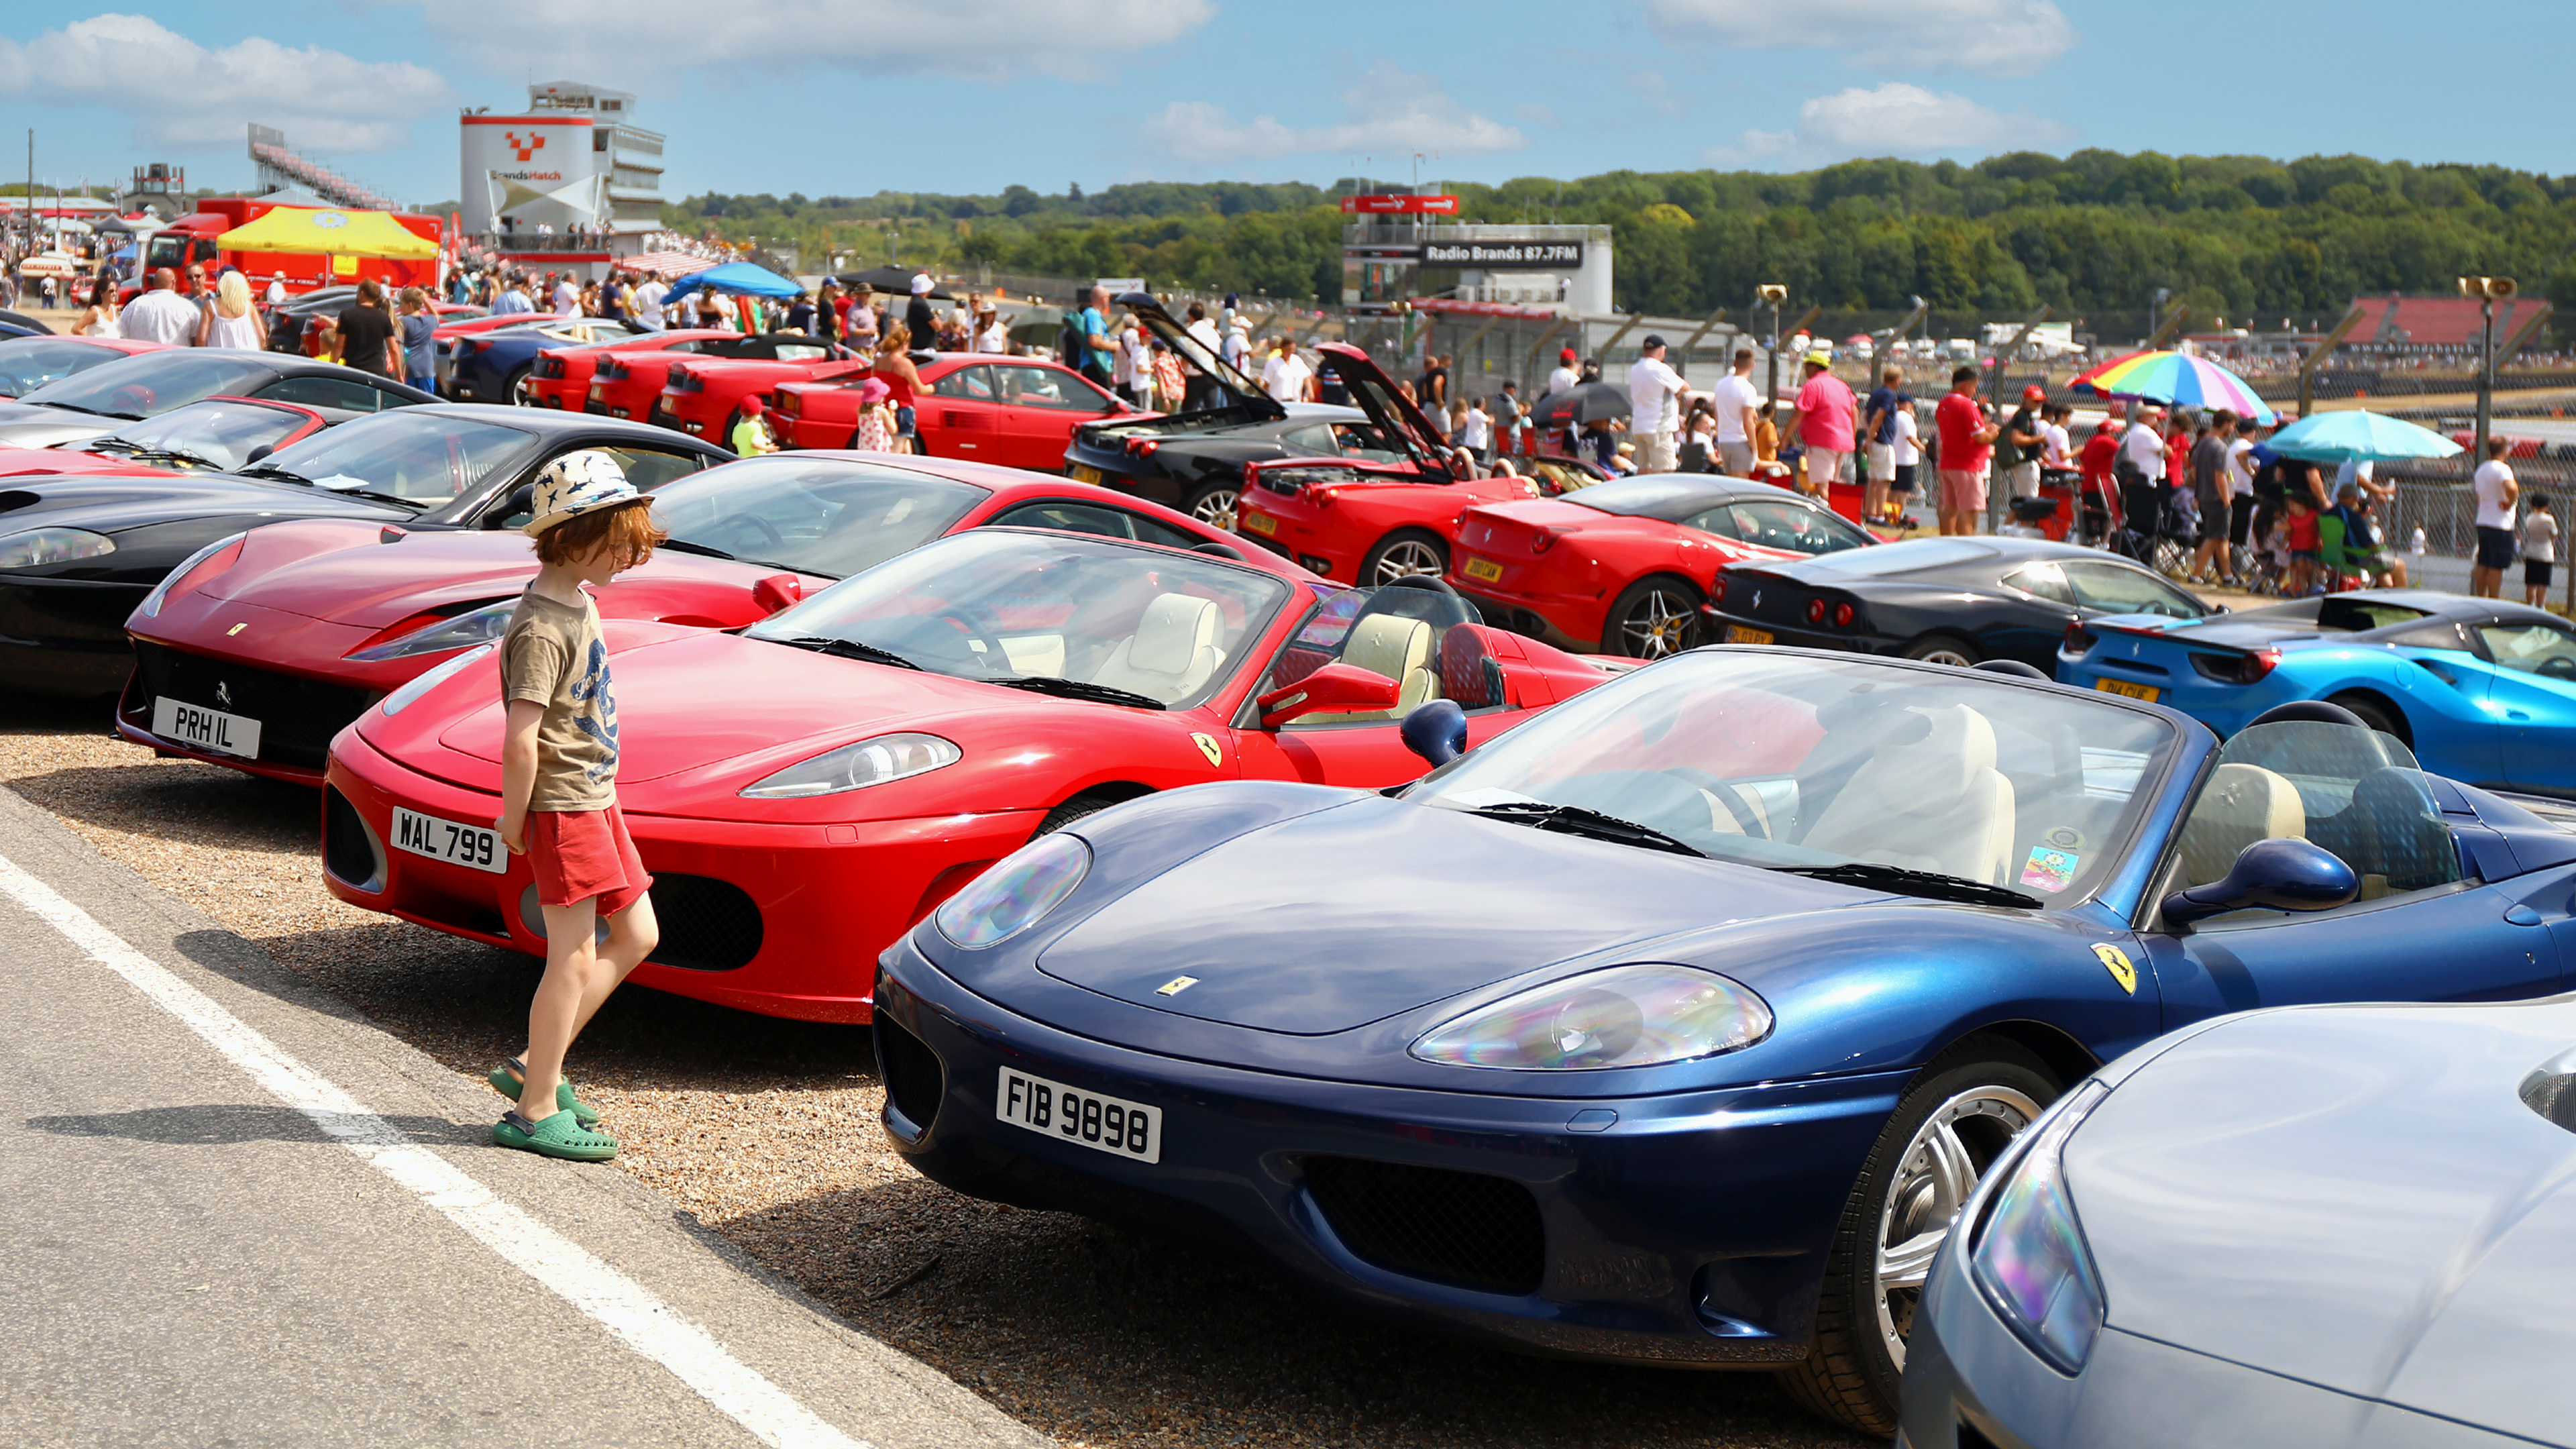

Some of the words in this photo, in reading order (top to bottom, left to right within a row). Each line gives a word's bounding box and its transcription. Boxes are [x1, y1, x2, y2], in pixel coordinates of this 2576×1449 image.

[1427, 246, 1470, 260] Radio
[1472, 246, 1523, 260] Brands
[1524, 246, 1578, 260] 87.7FM
[175, 706, 212, 742] PRH
[400, 812, 437, 854] WAL
[445, 824, 493, 865] 799
[1061, 1092, 1148, 1154] 9898
